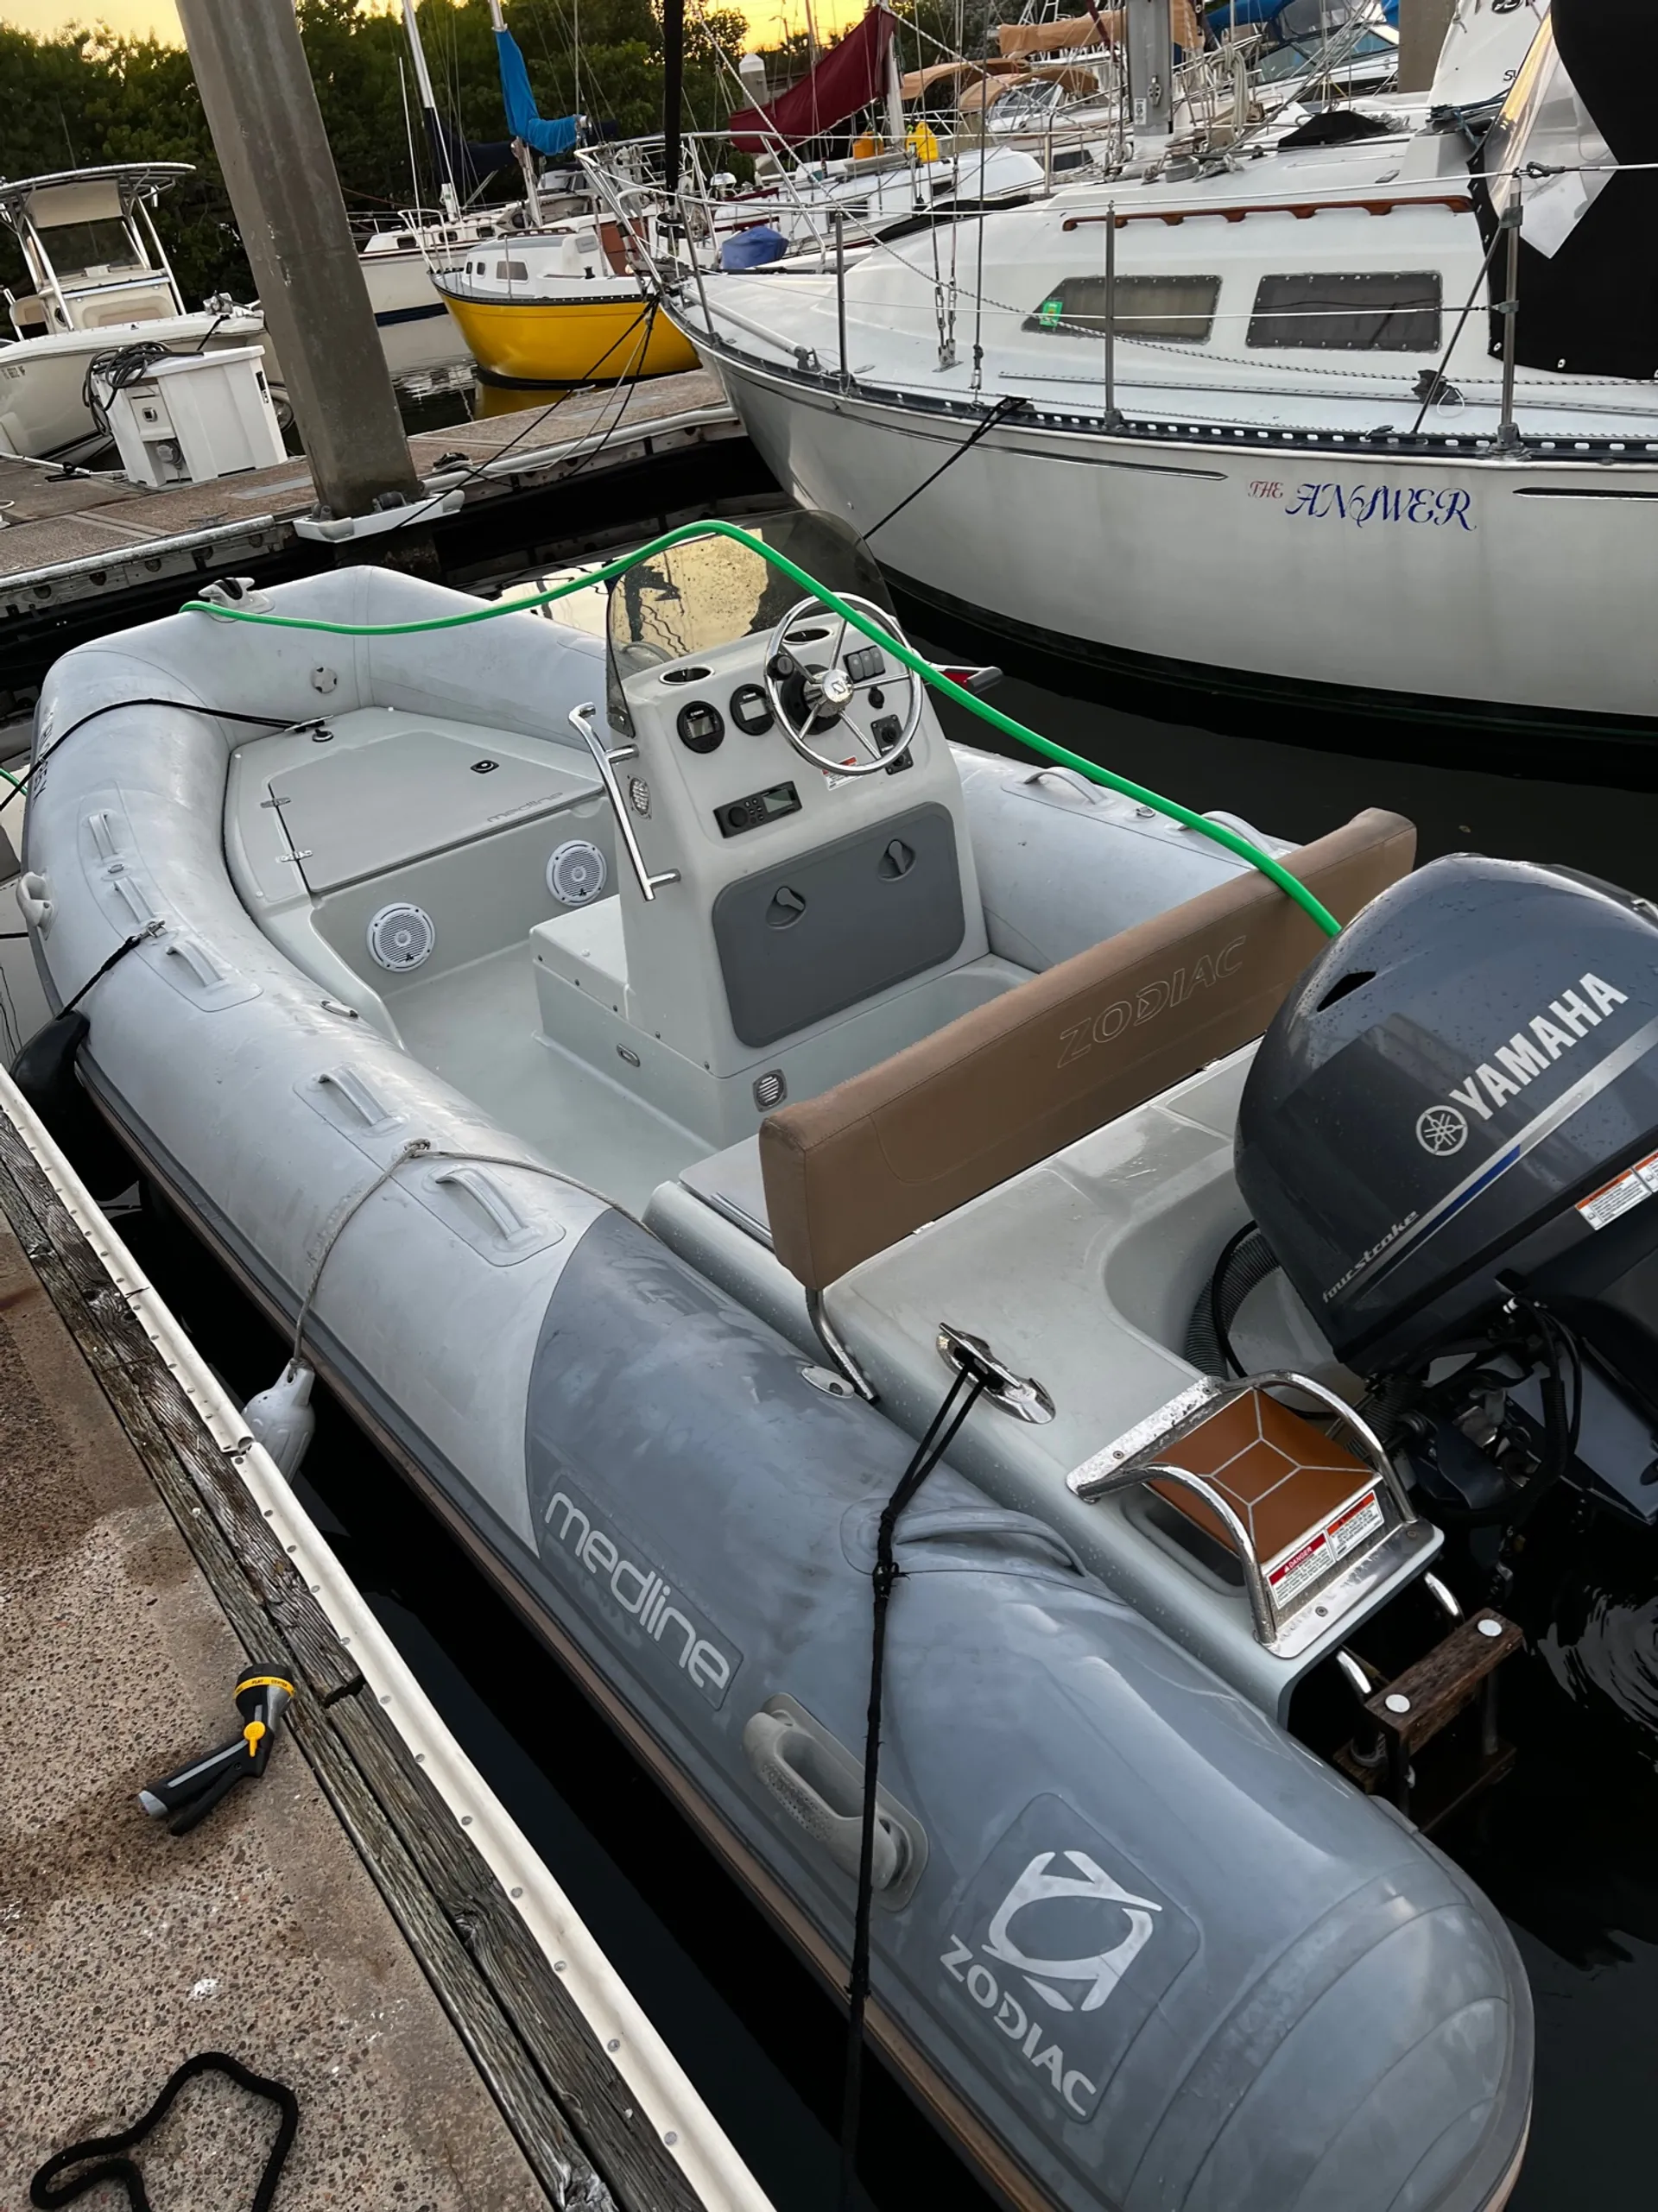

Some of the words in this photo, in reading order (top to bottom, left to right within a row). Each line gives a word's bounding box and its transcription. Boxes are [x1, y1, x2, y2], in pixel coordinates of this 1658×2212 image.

[1247, 481, 1284, 499] THE
[1285, 483, 1478, 532] ANSWER
[1057, 935, 1247, 1069] ZODIAC
[1448, 972, 1630, 1121] YAMAHA
[544, 1491, 731, 1690] medline
[940, 1934, 1097, 2117] ZODIAC
